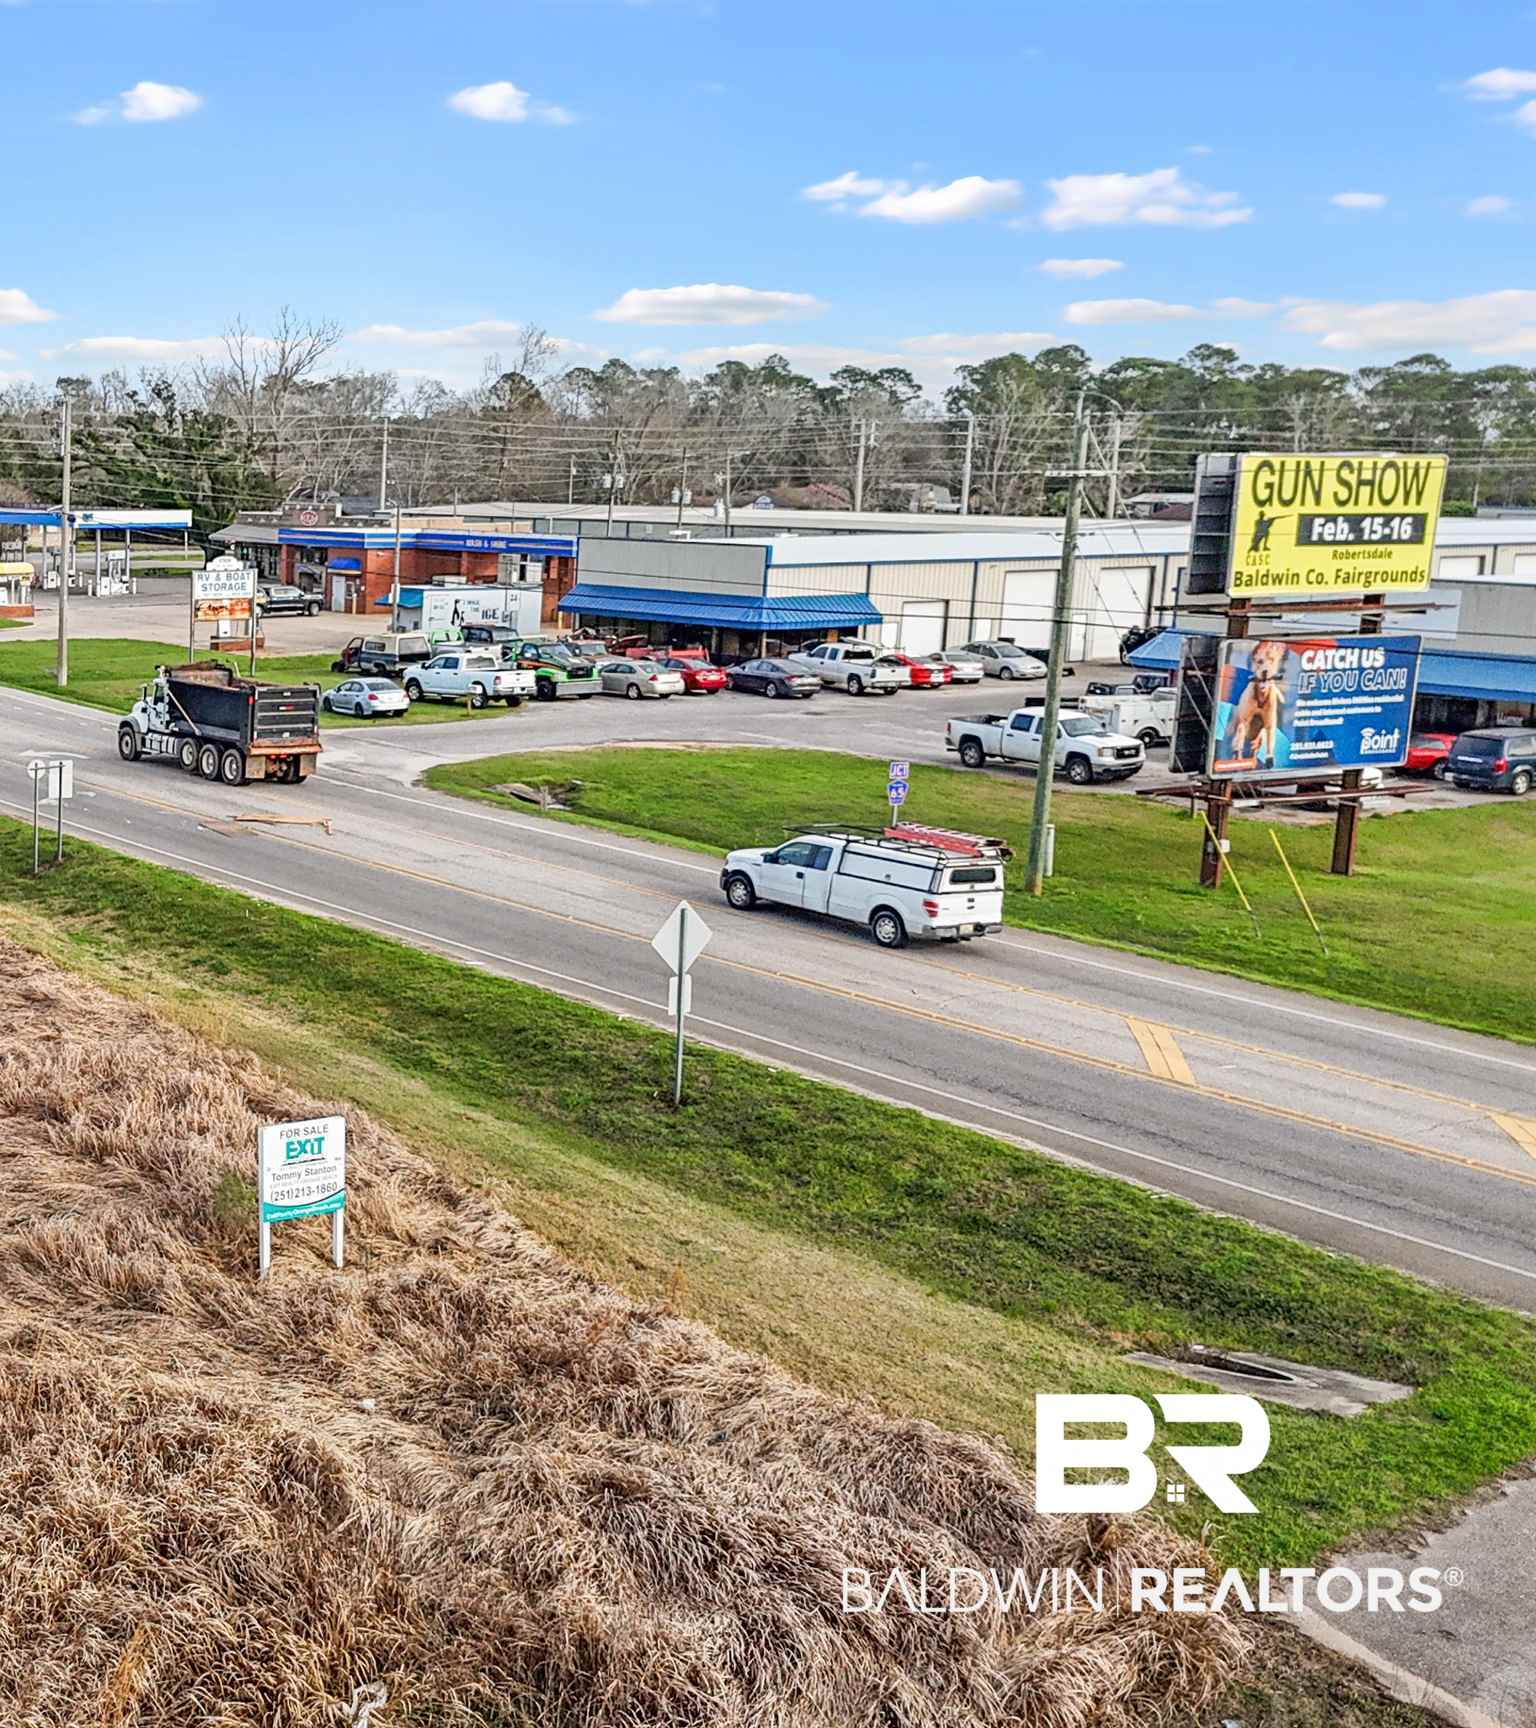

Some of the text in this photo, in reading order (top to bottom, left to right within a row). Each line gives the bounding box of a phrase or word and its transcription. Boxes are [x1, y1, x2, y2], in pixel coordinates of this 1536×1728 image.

[1251, 460, 1432, 508] GUN SHOW
[1311, 516, 1412, 541] Feb. 15-16
[1331, 547, 1393, 561] Robertsdale
[197, 573, 210, 582] RV
[226, 572, 251, 582] BOAT
[201, 582, 247, 592] STORAGE
[1233, 566, 1426, 589] Baldwin Co. Fairgrounds
[1301, 647, 1385, 670] CATCH US
[1298, 667, 1408, 694] IF YOU CAN!
[280, 1124, 328, 1139] FOR SALE
[286, 1136, 325, 1160] EXIT
[272, 1170, 302, 1182] Tommy
[304, 1165, 337, 1177] Stanton
